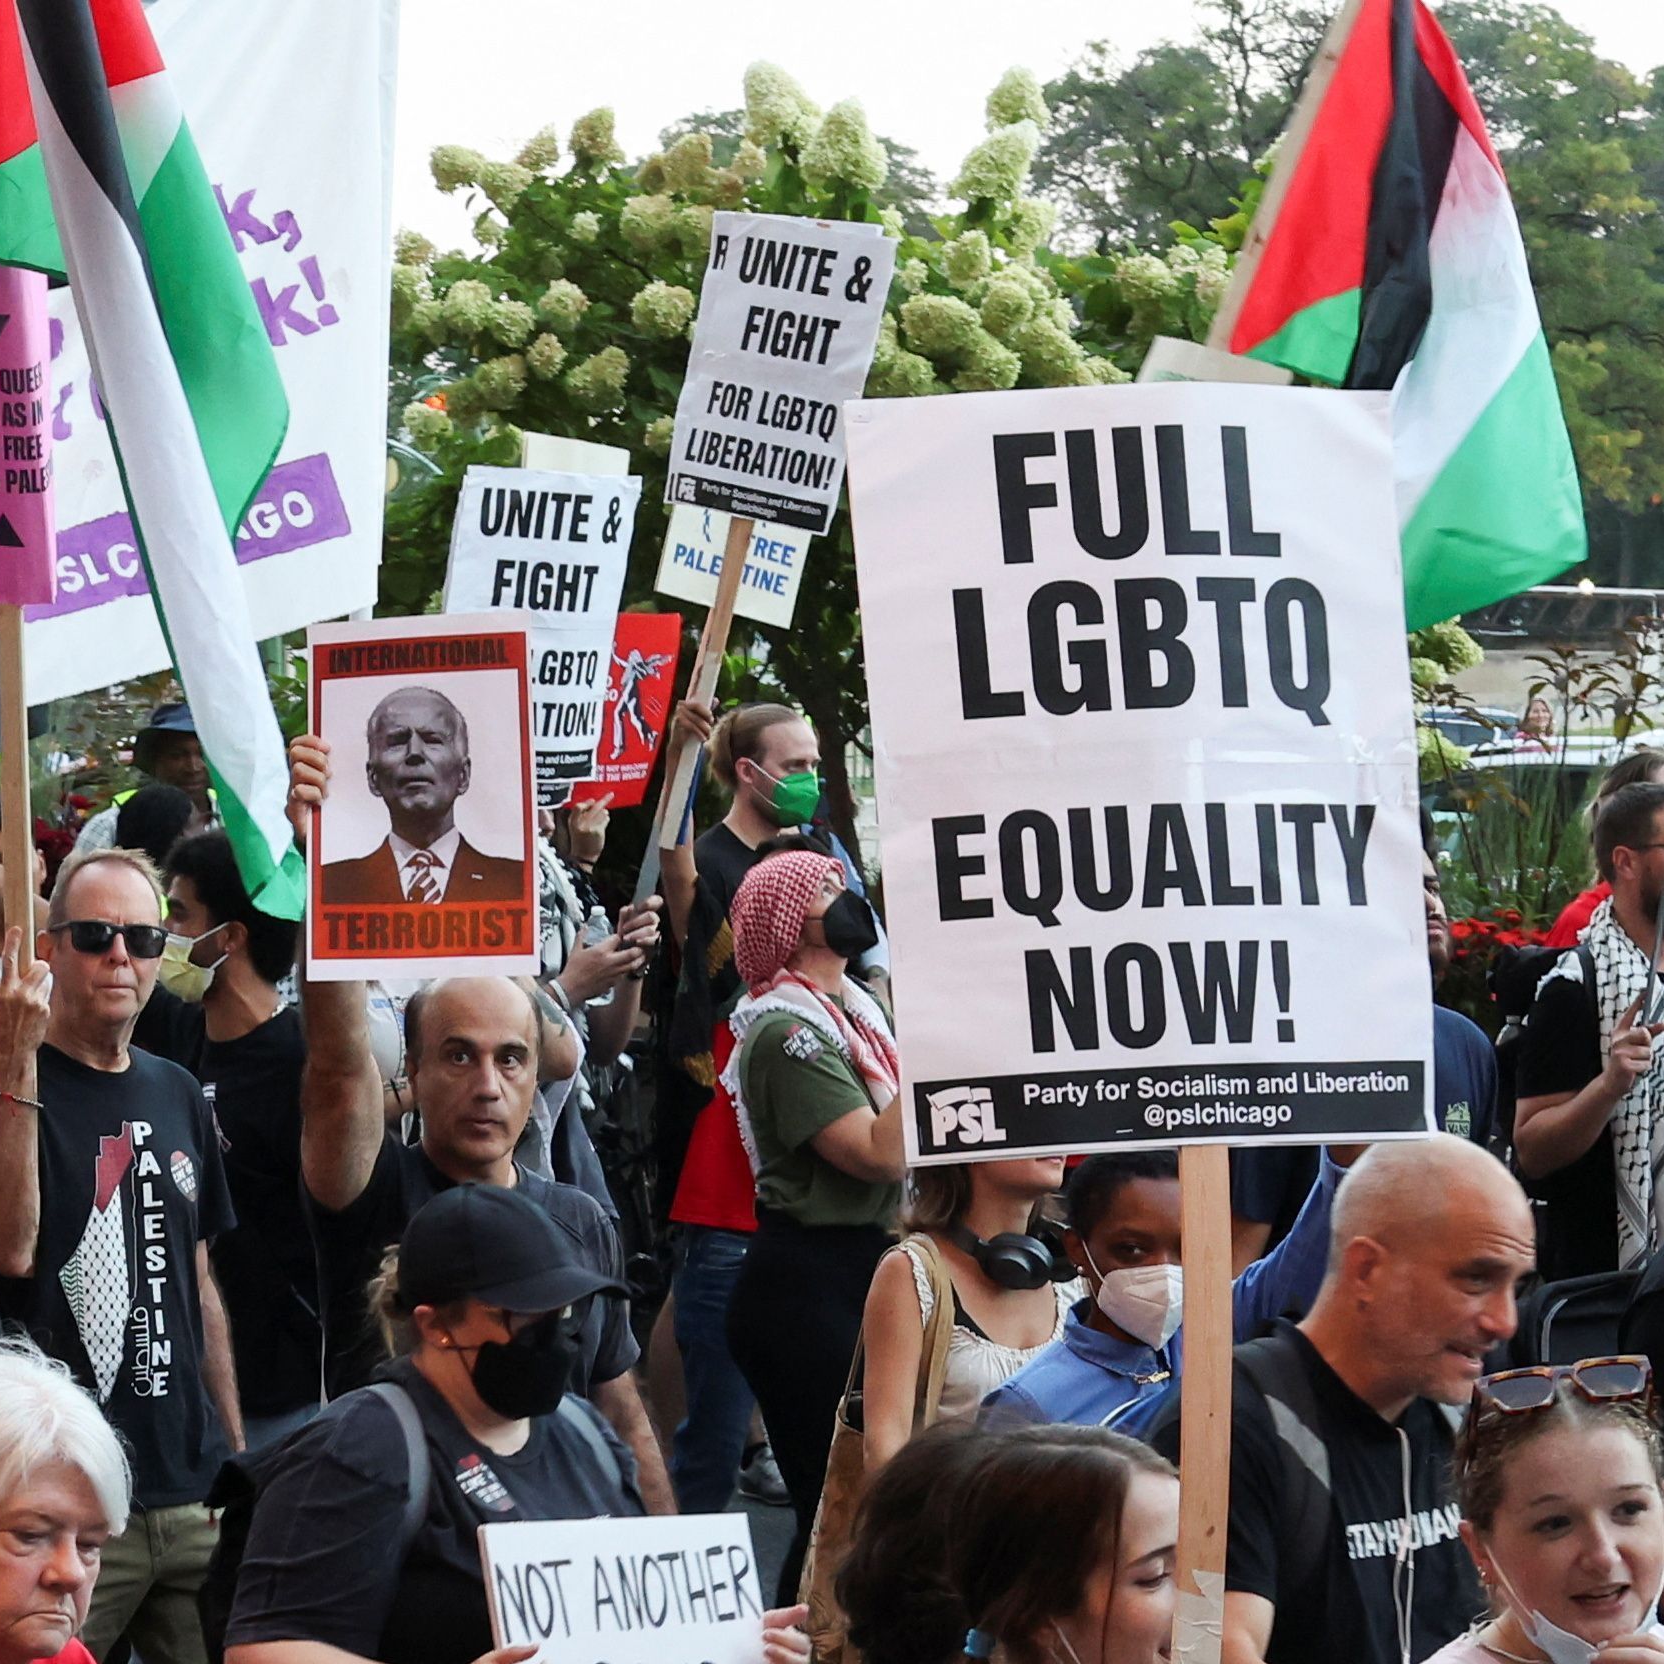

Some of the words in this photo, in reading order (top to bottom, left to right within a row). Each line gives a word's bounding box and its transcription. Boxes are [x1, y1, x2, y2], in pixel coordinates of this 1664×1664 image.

[738, 236, 838, 297] UNITE
[845, 255, 873, 304] &
[740, 305, 841, 365] FIGHT
[2, 403, 27, 428] AS
[707, 381, 753, 421] FOR
[756, 390, 838, 443] LGBTQ
[3, 434, 44, 461] FREE
[684, 428, 836, 490] LIBERATION!
[480, 487, 593, 543] UNITE
[602, 496, 622, 544] &
[993, 424, 1281, 566] FULL
[673, 543, 789, 596] PALETINE
[751, 535, 796, 568] REE
[491, 559, 599, 613] FIGHT
[330, 638, 509, 674] INTERNATIONAL
[531, 649, 598, 689] GBTQ
[951, 577, 1333, 726] LGBTQ
[932, 802, 1377, 928] EQUALITY
[324, 908, 528, 950] TERRORIST
[1024, 939, 1295, 1055] NOW!
[1023, 1081, 1089, 1111] Party
[1094, 1077, 1131, 1104] for
[1137, 1074, 1251, 1100] Socialism
[1256, 1072, 1298, 1097] and
[1303, 1070, 1409, 1096] Liberation
[1143, 1102, 1293, 1132] @pslchicago
[929, 1100, 1006, 1147] PSL
[132, 1120, 171, 1397] PALESTINE
[495, 1558, 572, 1644] NOT
[594, 1545, 762, 1631] ANOTHER
